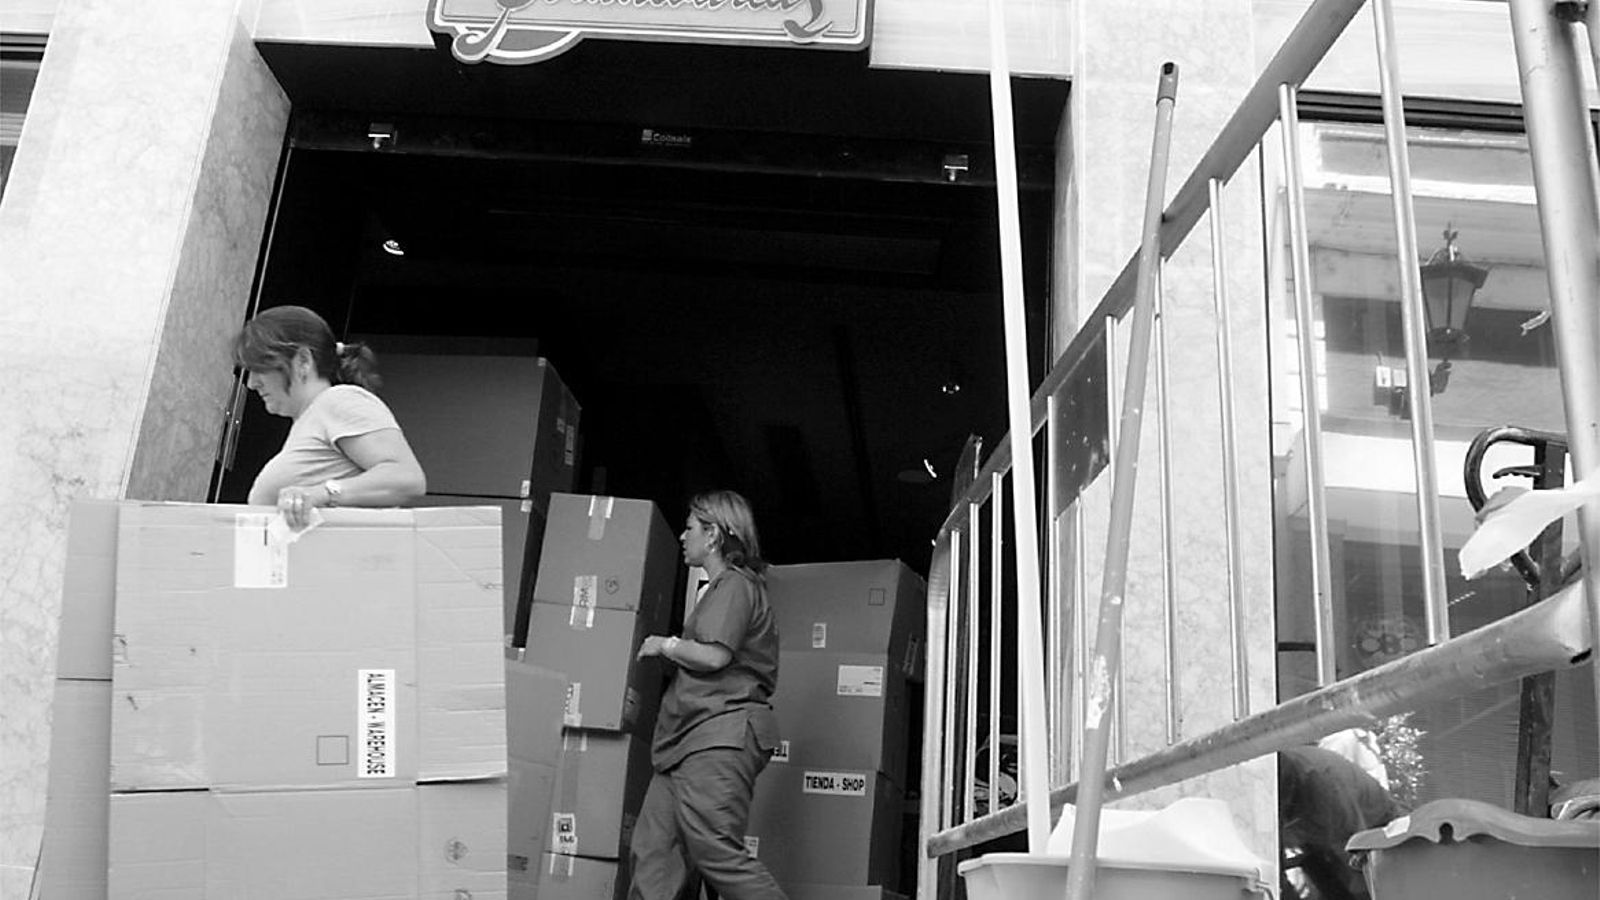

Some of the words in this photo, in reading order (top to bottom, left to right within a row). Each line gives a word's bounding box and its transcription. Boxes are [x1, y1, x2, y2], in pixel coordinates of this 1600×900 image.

[367, 673, 386, 714] ALMACEN
[367, 721, 386, 774] WAREHOUSE
[805, 776, 834, 790] TIENDA
[842, 777, 865, 791] SHOP
